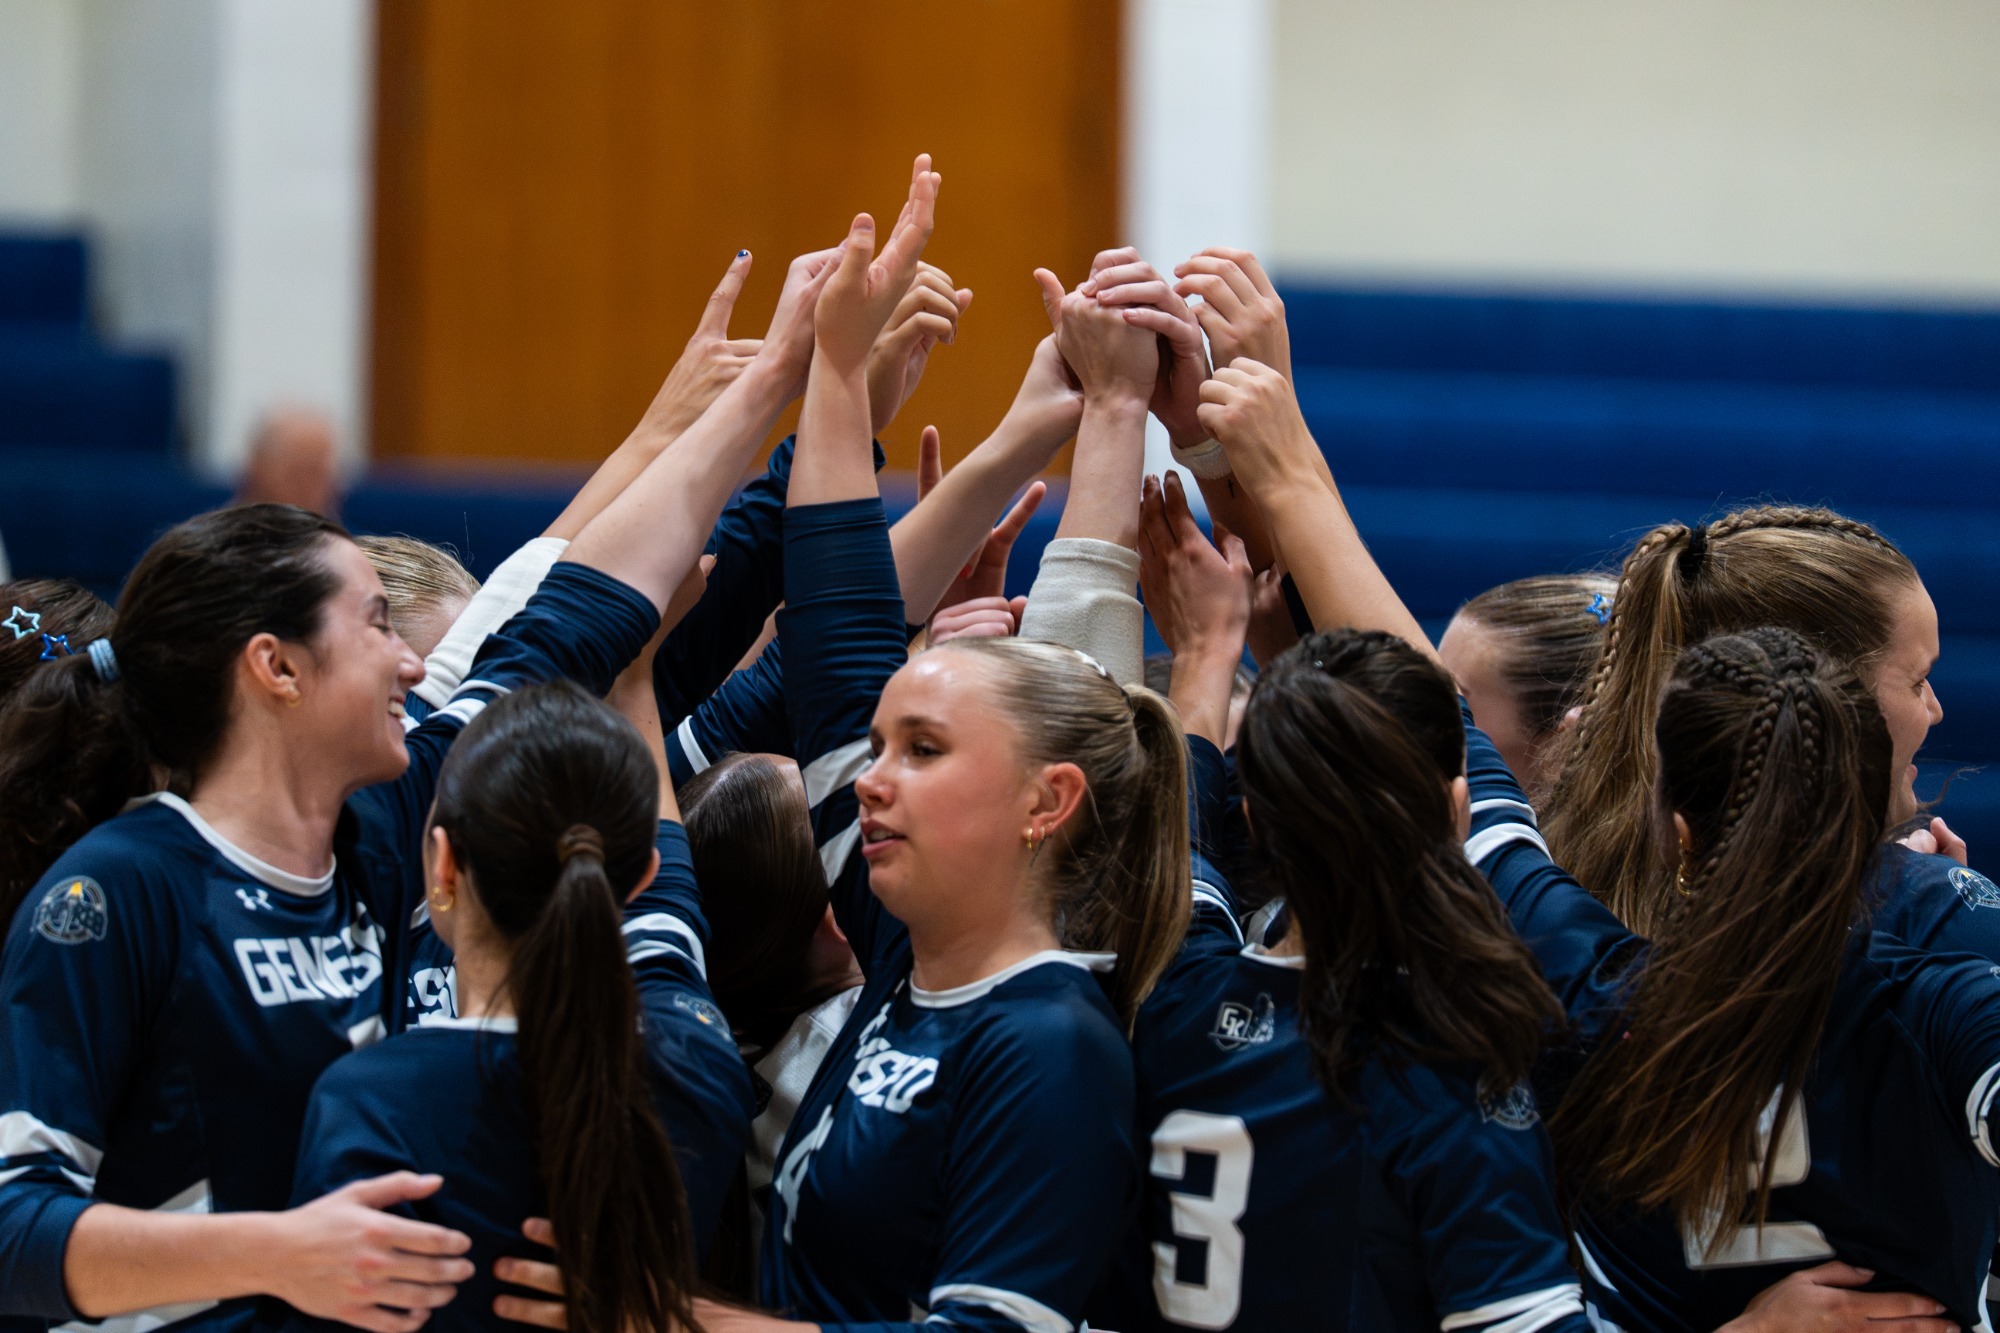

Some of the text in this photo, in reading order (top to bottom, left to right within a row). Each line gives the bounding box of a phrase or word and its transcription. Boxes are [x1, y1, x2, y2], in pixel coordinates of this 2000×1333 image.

[234, 904, 386, 1006] GENES
[1221, 1007, 1245, 1036] GK
[1150, 1108, 1254, 1330] 3
